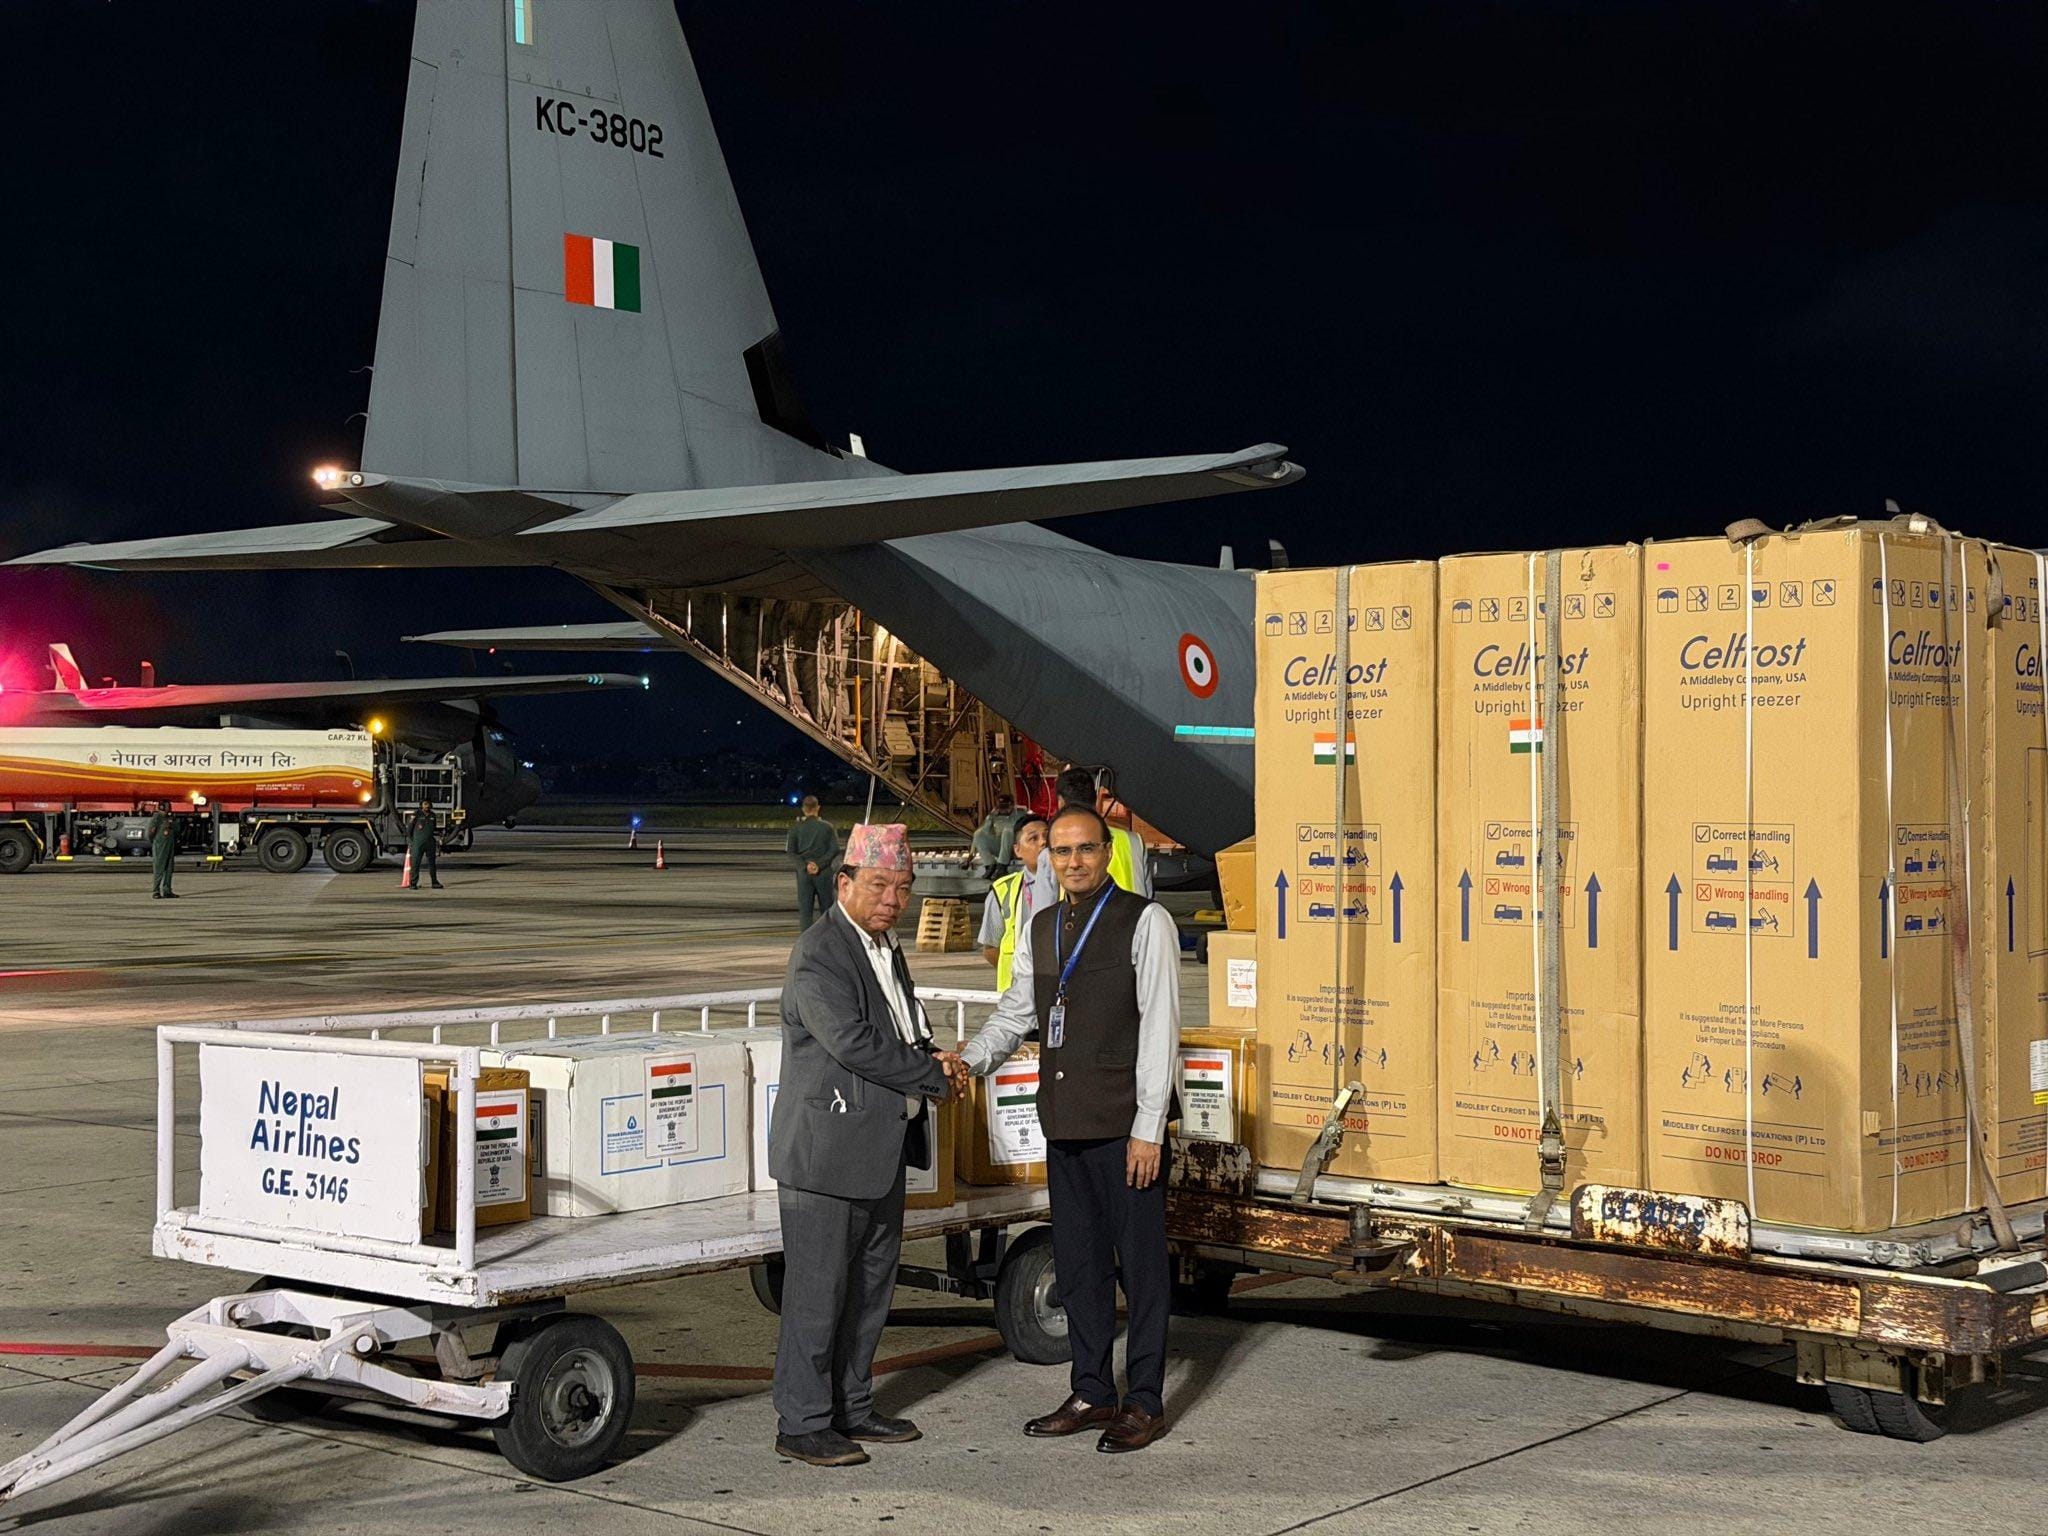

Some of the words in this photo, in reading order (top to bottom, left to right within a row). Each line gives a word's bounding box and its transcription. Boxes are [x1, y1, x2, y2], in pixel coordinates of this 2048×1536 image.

[537, 96, 664, 158] KC-3802
[1726, 589, 1734, 600] 2
[1915, 586, 1920, 598] 2
[1516, 601, 1523, 612] 2
[1321, 614, 1328, 625] 2
[1680, 632, 1807, 670] Celfrost
[1889, 630, 1962, 667] Celfrost
[1473, 642, 1589, 677] Celfrst
[1284, 654, 1388, 687] Celfost
[1473, 684, 1480, 692] A
[1482, 682, 1523, 692] Middleby
[1570, 681, 1590, 690] USA
[1680, 677, 1687, 686] A
[1690, 674, 1734, 687] Middleby
[1786, 672, 1807, 683] USA
[1284, 693, 1291, 701] A
[1292, 691, 1328, 701] Middleby
[1330, 690, 1368, 700] Cpany,
[1370, 689, 1388, 698] USA
[1890, 690, 1924, 709] Upright
[1475, 700, 1526, 716] Upright
[1681, 694, 1737, 712] Upright
[1740, 694, 1801, 707] Freezer
[1285, 708, 1330, 724] Upright
[1333, 708, 1384, 722] eezer
[111, 750, 156, 767] नेपाल
[163, 753, 212, 767] आयल
[221, 751, 263, 767] निगम
[1313, 829, 1340, 840] Correc
[1343, 829, 1378, 841] Handling
[1536, 829, 1575, 841] Hling
[1712, 829, 1747, 841] Correct
[1749, 830, 1791, 844] Handling
[1315, 884, 1340, 894] Wron
[1342, 884, 1377, 895] Handling
[1502, 882, 1530, 894] Wrong
[1715, 887, 1745, 901] Wrong
[1748, 889, 1789, 903] Handling
[1368, 998, 1390, 1007] Persons
[1506, 989, 1541, 1002] Importa
[1481, 1002, 1510, 1010] suggested
[1506, 1012, 1521, 1020] Move
[1691, 1014, 1724, 1023] suggested
[1724, 1016, 1737, 1024] that
[1760, 1018, 1776, 1028] More
[1777, 1020, 1804, 1030] Persons
[1485, 1020, 1496, 1028] Use
[1497, 1021, 1516, 1031] Proper
[1517, 1023, 1536, 1033] Lifting
[1700, 1024, 1710, 1033] Lift
[1719, 1026, 1736, 1035] Move
[1747, 1030, 1780, 1039] ppliance
[1695, 1034, 1708, 1043] Use
[1709, 1035, 1731, 1046] Proper
[1752, 1039, 1786, 1050] Procedure
[258, 1080, 339, 1122] Nepal
[1381, 1101, 1391, 1110] (P)
[1306, 1114, 1319, 1125] DO
[1344, 1118, 1370, 1130] DROP
[1577, 1113, 1588, 1122] (P)
[1494, 1125, 1509, 1137] DO
[1511, 1126, 1532, 1140] NOT
[1795, 1134, 1808, 1145] (P)
[250, 1118, 361, 1164] Airlines
[1705, 1145, 1722, 1159] DO
[1724, 1148, 1747, 1162] NOT
[1750, 1151, 1783, 1166] DROP
[262, 1167, 298, 1197] G.E.
[305, 1172, 349, 1203] 3146
